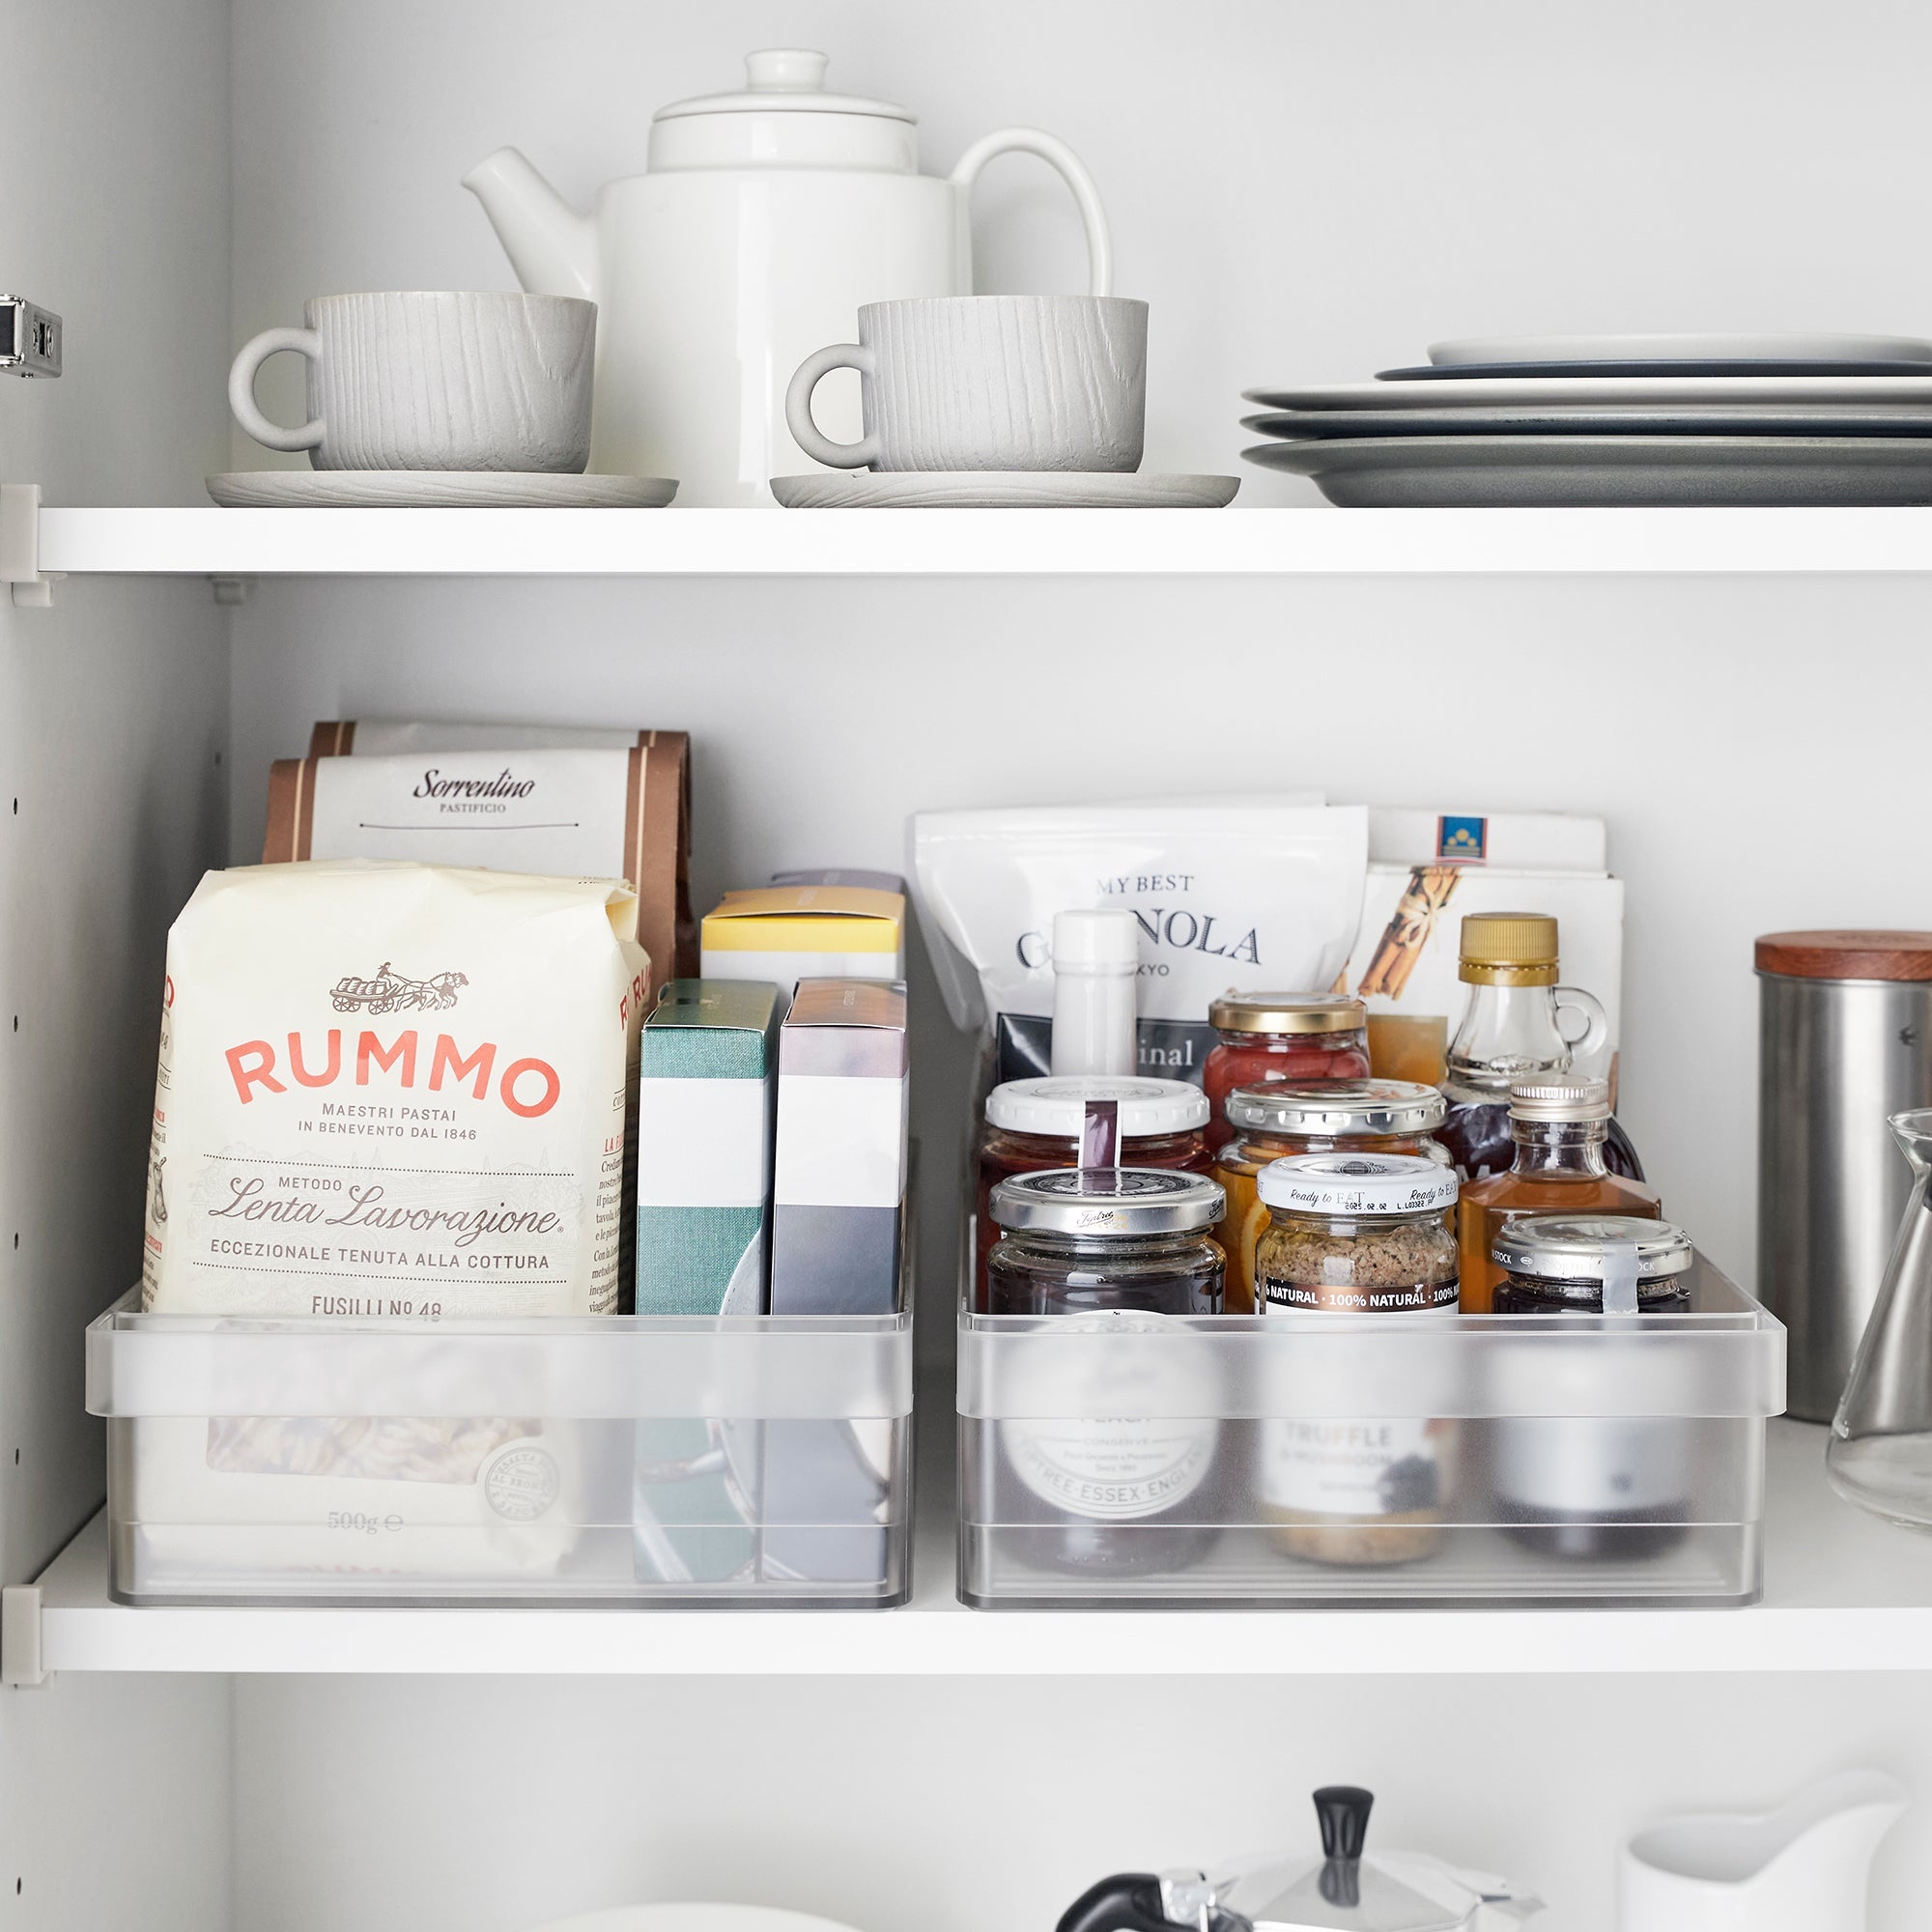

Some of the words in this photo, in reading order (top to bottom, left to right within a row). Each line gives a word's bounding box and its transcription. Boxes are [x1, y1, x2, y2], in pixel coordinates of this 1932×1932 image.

[413, 767, 535, 798] Sorrentino
[440, 803, 506, 814] PASTIFICIO
[1096, 877, 1130, 895] MY
[1136, 874, 1195, 893] BEST
[1016, 908, 1262, 970] GNOLA
[1135, 963, 1170, 977] KYO
[225, 1029, 560, 1118] RUMMO
[322, 1102, 394, 1121] MAESTRI
[401, 1107, 456, 1122] PASTAI
[298, 1121, 313, 1132] IN
[319, 1122, 404, 1138] BENEVENTO
[411, 1126, 438, 1140] DAL
[444, 1128, 477, 1141] 1846
[278, 1176, 343, 1192] METODO
[1410, 1188, 1436, 1201] Ready
[1437, 1186, 1445, 1197] to
[208, 1177, 325, 1223] Lenta
[1290, 1189, 1320, 1208] Ready
[1321, 1194, 1333, 1204] to
[1337, 1191, 1365, 1205] EAT
[211, 1238, 331, 1262] ECCEZIONALE
[338, 1248, 409, 1266] TENUTA
[415, 1253, 461, 1268] ALLA
[468, 1255, 551, 1270] COTTURA
[312, 1295, 383, 1316] FUSILLI
[1271, 1286, 1320, 1305] NATURAL
[1329, 1293, 1367, 1307] 100%
[1370, 1292, 1427, 1308] NATURAL
[1434, 1286, 1454, 1302] 100%
[1285, 1423, 1392, 1447] TRUFFLE
[1081, 1488, 1140, 1502] ESSEX
[327, 1511, 379, 1535] 500g
